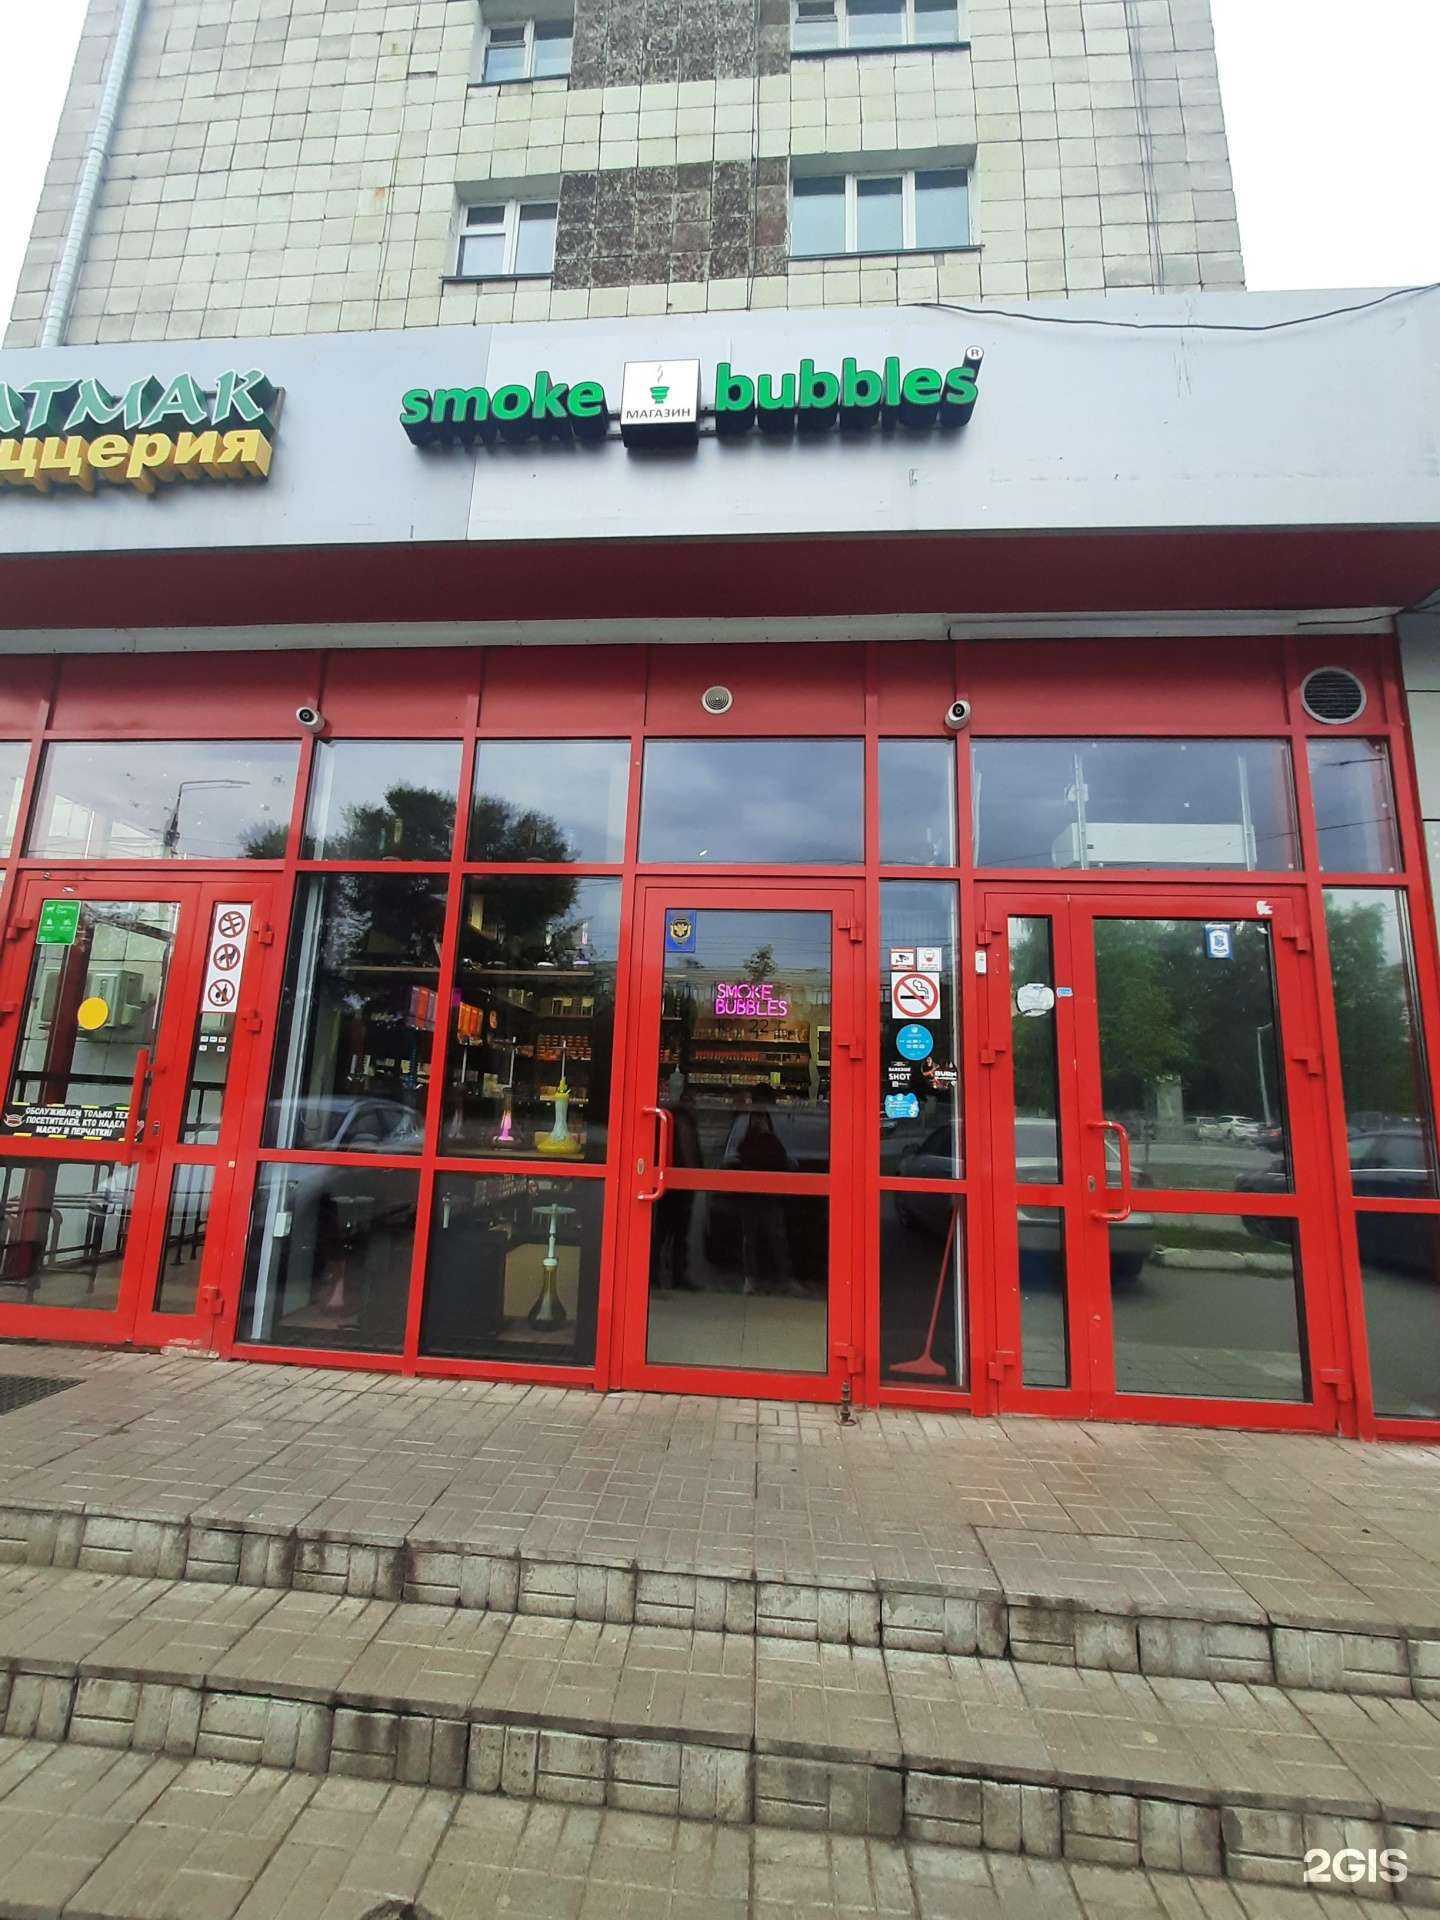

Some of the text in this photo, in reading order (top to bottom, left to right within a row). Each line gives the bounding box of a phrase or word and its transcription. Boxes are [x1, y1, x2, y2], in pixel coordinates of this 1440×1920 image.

[715, 356, 979, 412] bubbles
[400, 370, 605, 424] smoke
[626, 408, 691, 419] МАГАЗИН
[717, 983, 773, 1001] SMOKE
[715, 998, 788, 1016] BUBBLES
[25, 1107, 82, 1118] ОБСЛУЖИВАЕМ
[84, 1109, 113, 1119] ТОЛЬКО
[36, 1125, 62, 1134] МАСКУ
[82, 1119, 98, 1127] КТО
[98, 1120, 125, 1129] НАДЕЛ
